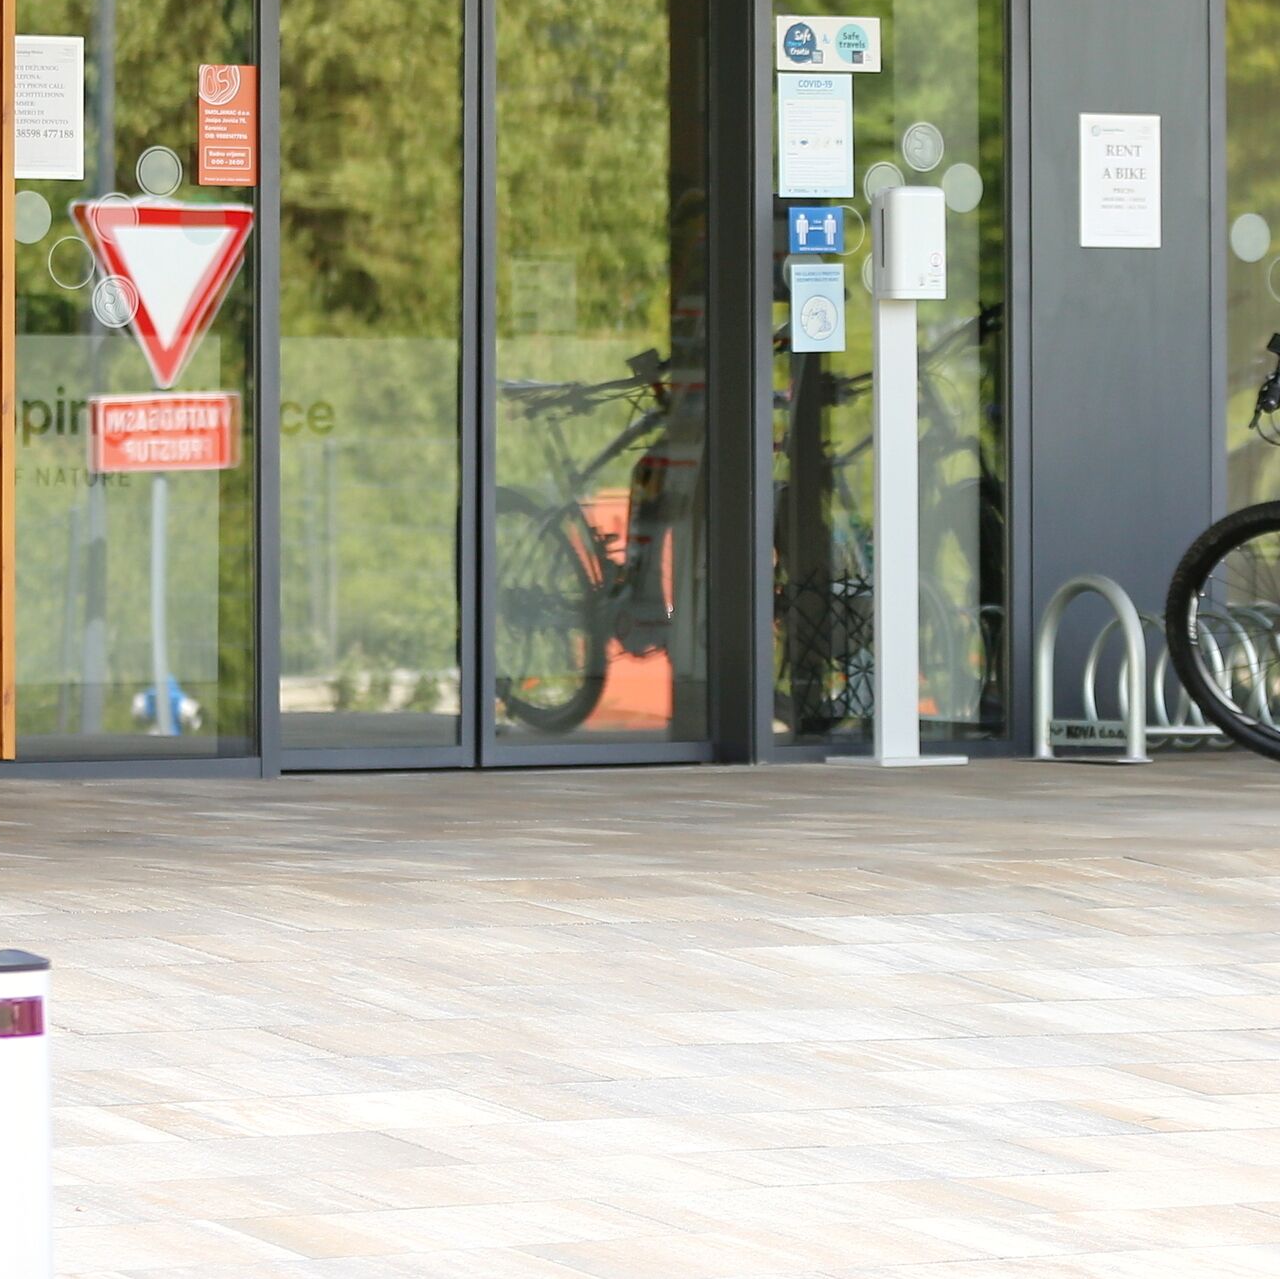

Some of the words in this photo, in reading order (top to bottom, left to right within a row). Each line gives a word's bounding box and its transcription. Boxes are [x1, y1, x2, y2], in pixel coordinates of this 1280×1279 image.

[842, 32, 860, 40] Safe
[839, 41, 866, 49] travels
[798, 79, 833, 89] COVID-19
[42, 129, 58, 138] 477
[59, 129, 74, 138] 188
[1105, 144, 1143, 157] RENT
[1102, 168, 1112, 180] A
[1115, 168, 1148, 180] BIKE
[36, 466, 131, 488] NATURE
